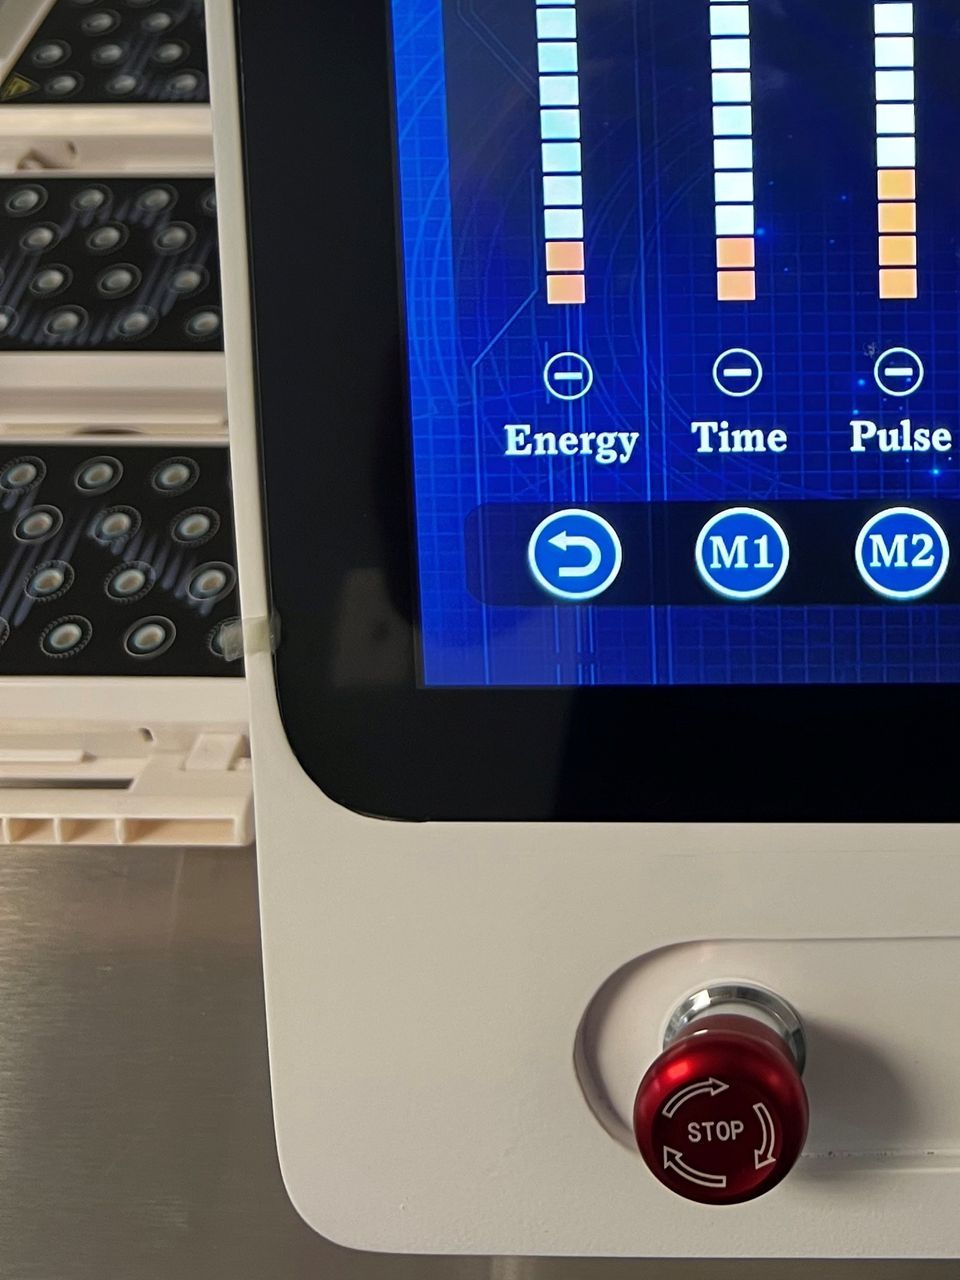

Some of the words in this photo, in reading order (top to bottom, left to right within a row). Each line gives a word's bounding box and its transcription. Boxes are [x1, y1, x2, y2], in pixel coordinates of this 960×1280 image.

[503, 424, 640, 464] Energy
[690, 420, 788, 453] Time
[849, 418, 952, 452] Pulse
[708, 532, 775, 570] M1
[869, 531, 935, 569] M2
[687, 1120, 744, 1142] STOP
